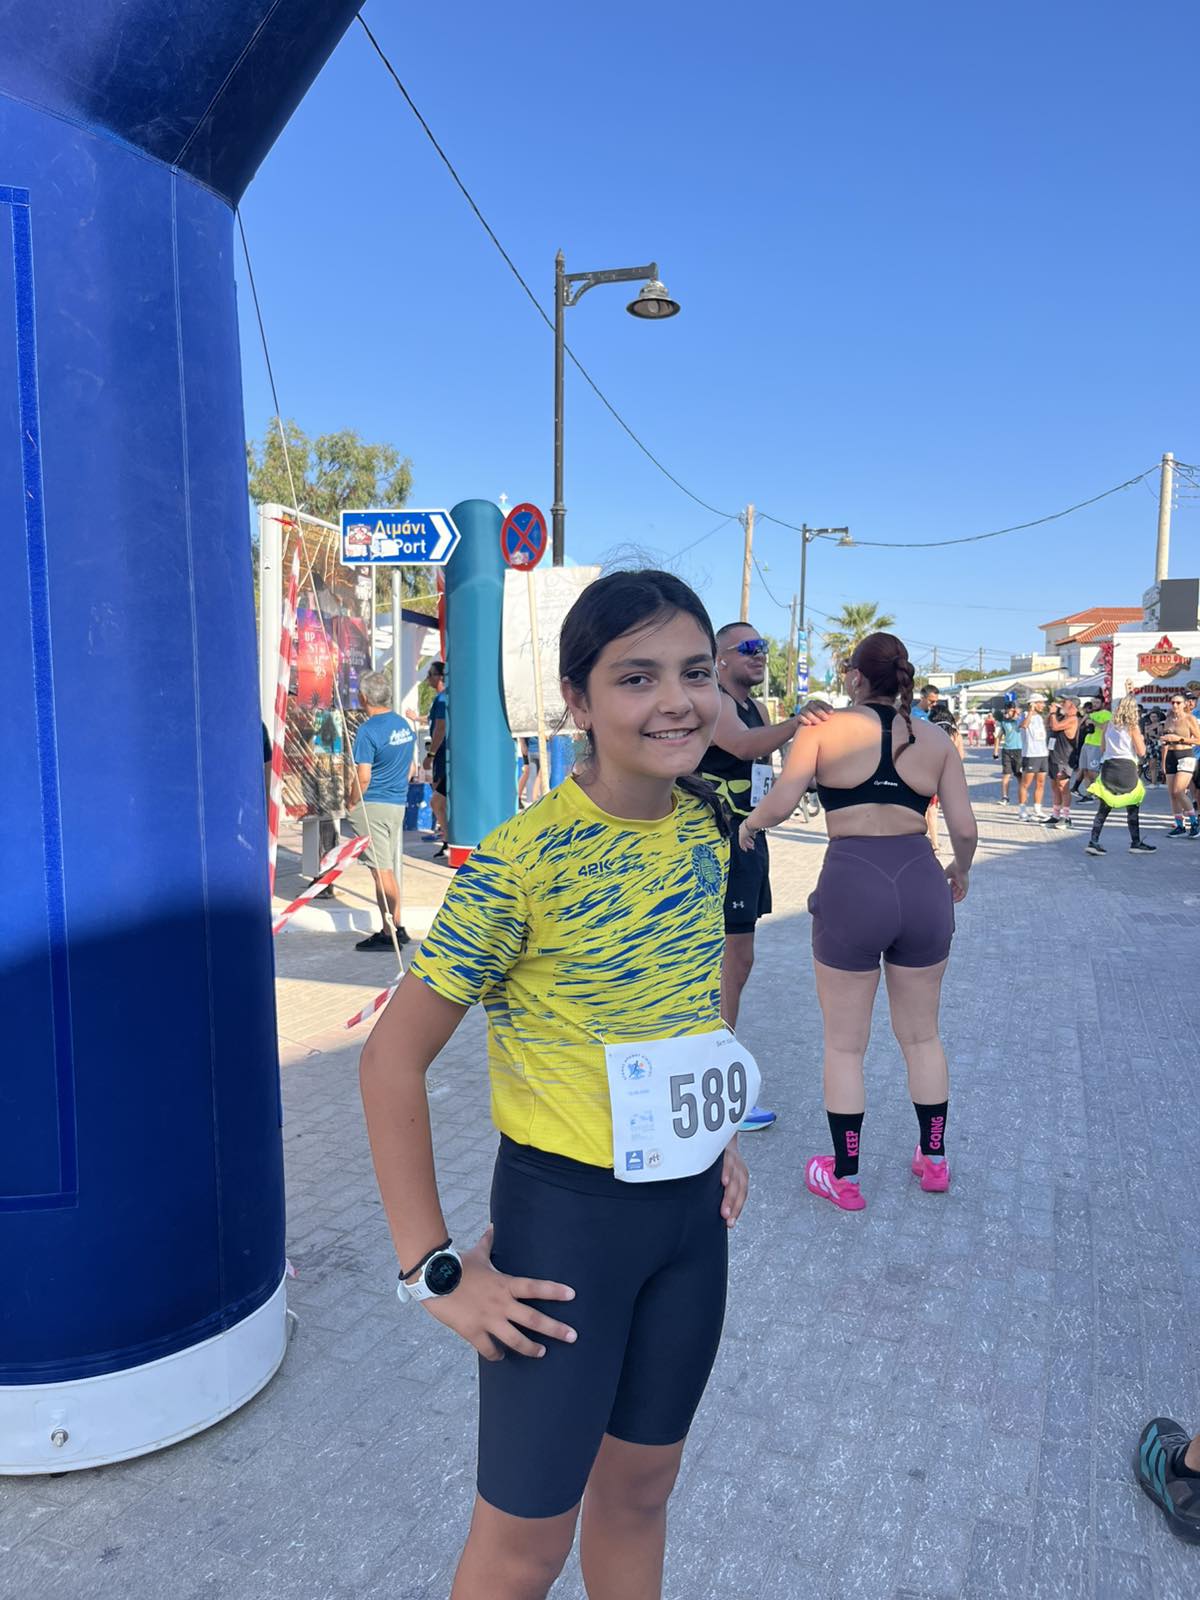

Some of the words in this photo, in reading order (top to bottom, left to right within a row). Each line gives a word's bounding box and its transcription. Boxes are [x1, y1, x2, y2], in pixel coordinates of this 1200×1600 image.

[373, 519, 426, 538] Λιμάνι
[1156, 685, 1185, 694] house
[669, 1061, 747, 1139] 589
[845, 1130, 859, 1157] KEEP
[929, 1116, 944, 1150] GOING
